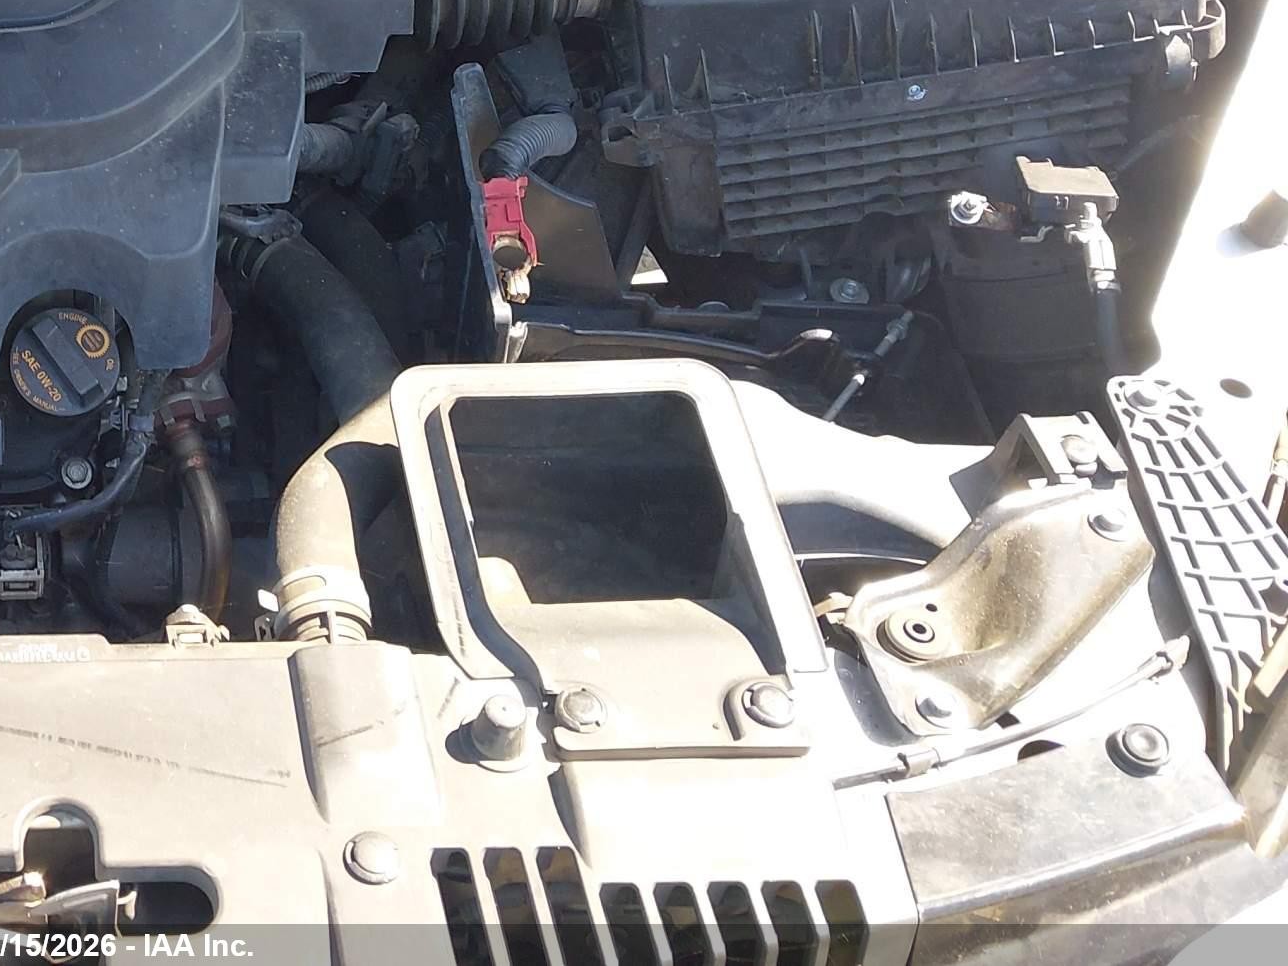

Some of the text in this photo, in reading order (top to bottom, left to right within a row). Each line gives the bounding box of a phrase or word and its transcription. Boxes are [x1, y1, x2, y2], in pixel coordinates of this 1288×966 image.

[58, 312, 88, 324] ENGINE
[21, 350, 62, 402] SAE 0W-20
[32, 395, 58, 412] MANUAL
